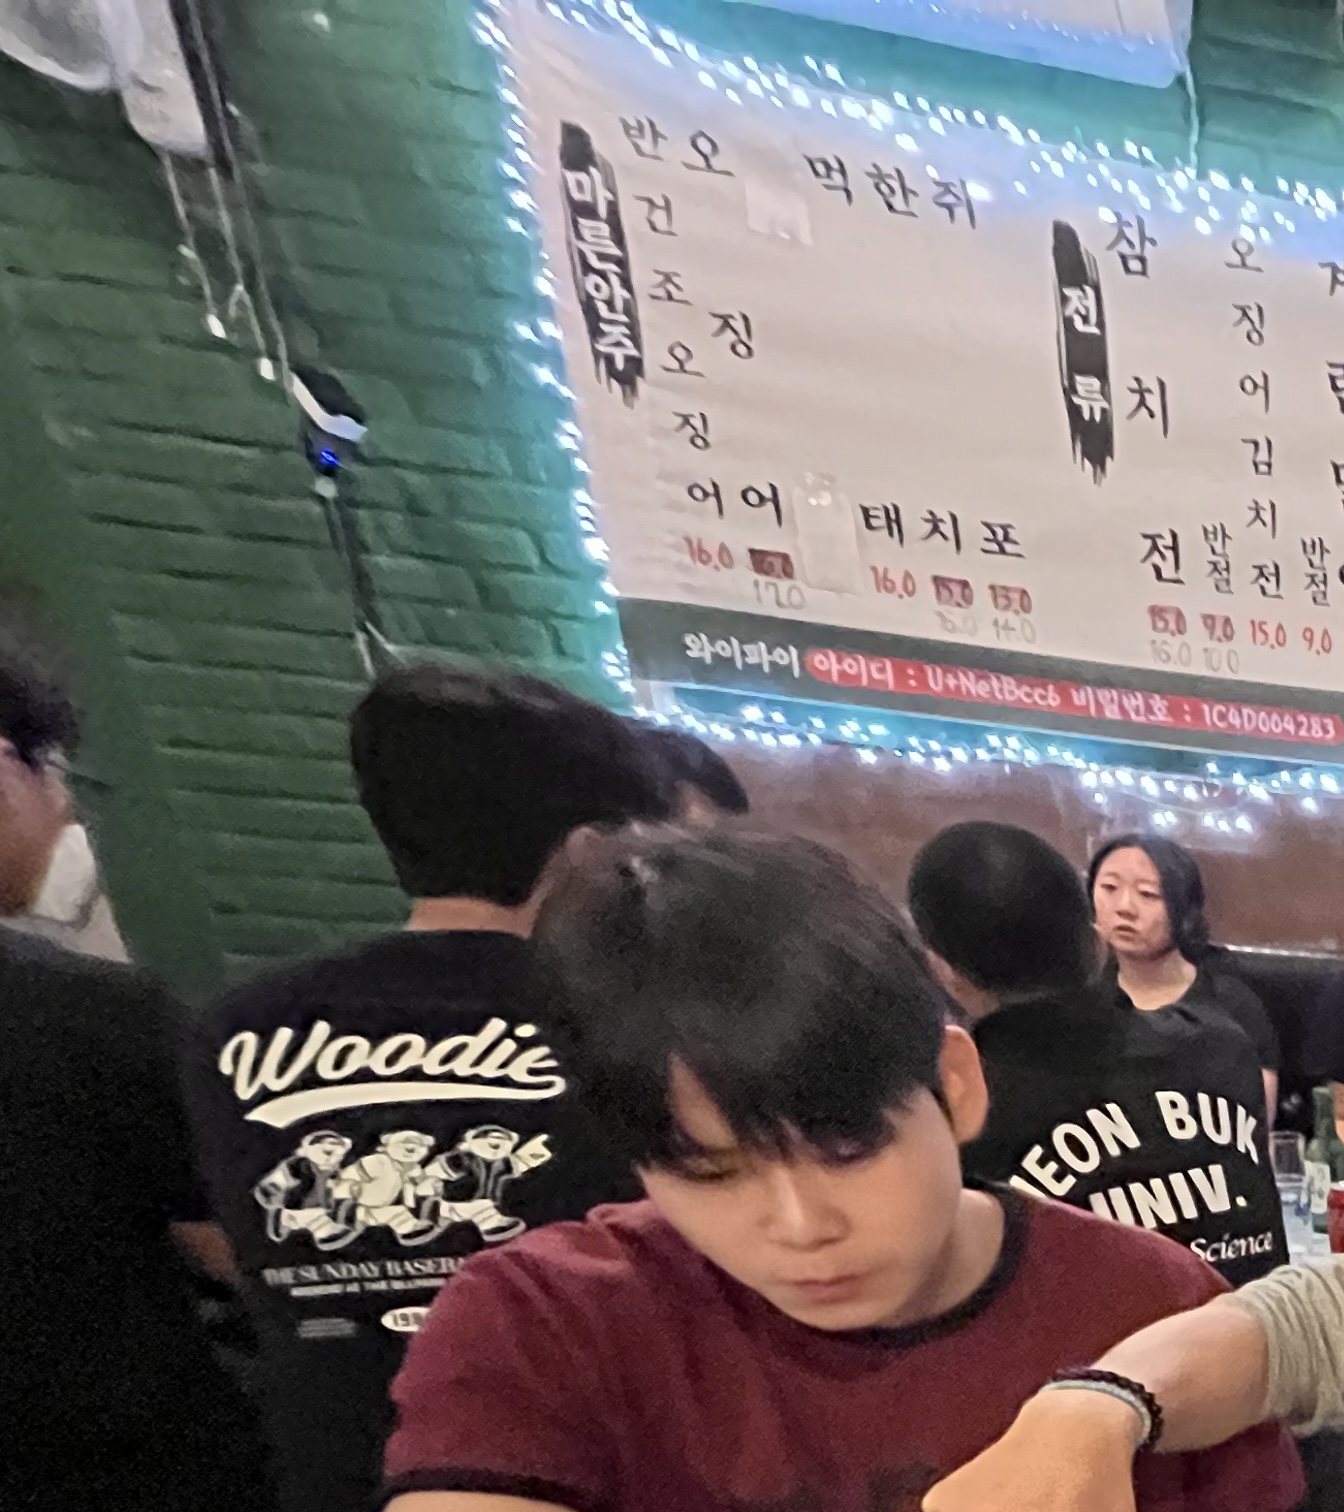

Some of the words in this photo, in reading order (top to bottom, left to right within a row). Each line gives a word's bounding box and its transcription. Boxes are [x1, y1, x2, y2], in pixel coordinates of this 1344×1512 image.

[563, 165, 643, 372] 마른안주
[619, 116, 724, 520] 반건조오징어
[1062, 283, 1110, 424] 전류
[1106, 211, 1186, 585] 참치전
[1224, 238, 1284, 600] 오징어김치전
[1201, 522, 1234, 594] 반절
[1300, 536, 1331, 606] 반절
[684, 632, 800, 678] 와이파이
[812, 652, 895, 690] 아이디
[1071, 684, 1172, 724] 비밀번호
[1250, 619, 1287, 650] 15.0
[1302, 626, 1333, 656] 9.0
[1155, 1090, 1259, 1164] BUK
[1089, 1164, 1248, 1230] UNIV.
[1190, 1231, 1273, 1263] Science
